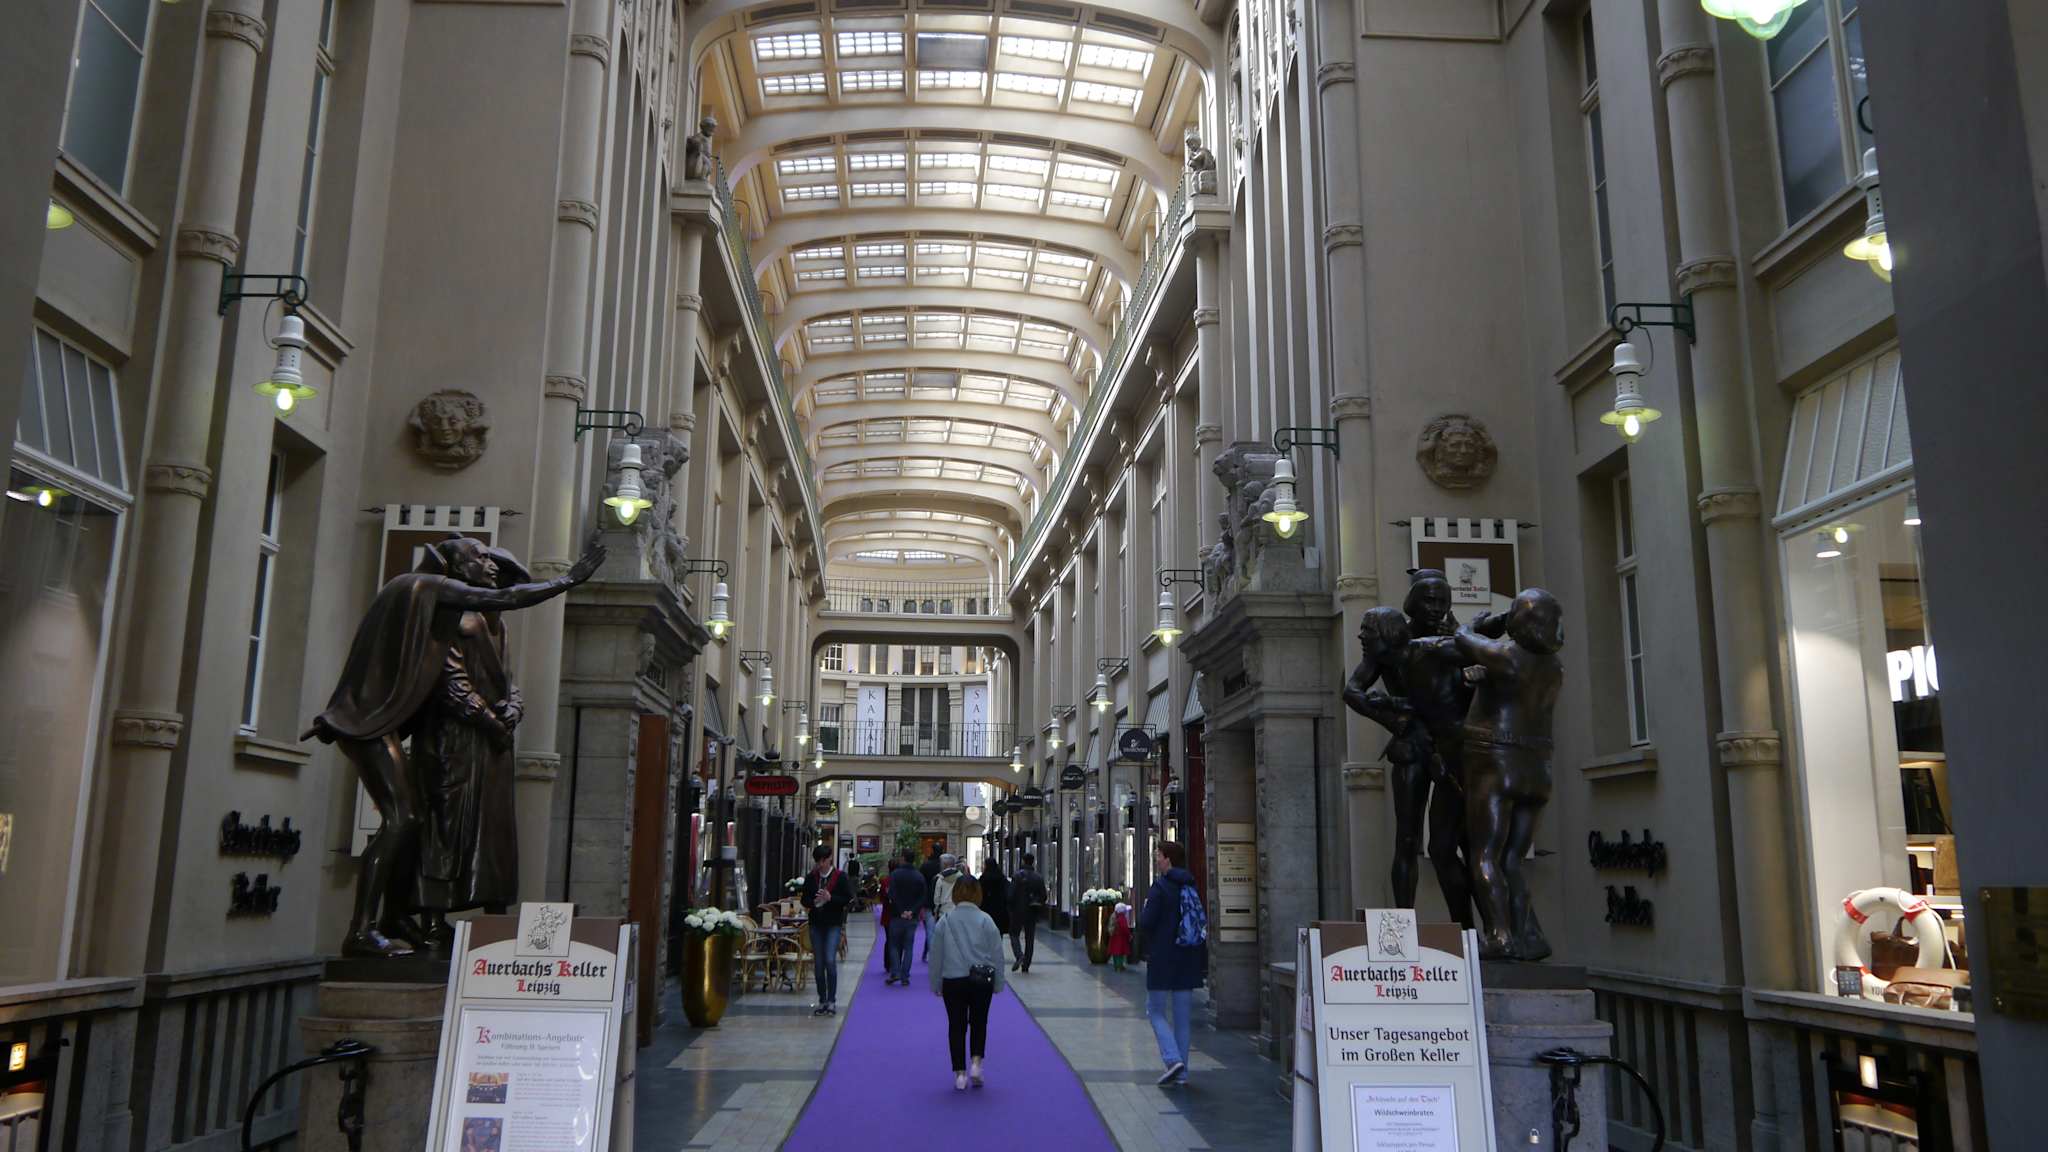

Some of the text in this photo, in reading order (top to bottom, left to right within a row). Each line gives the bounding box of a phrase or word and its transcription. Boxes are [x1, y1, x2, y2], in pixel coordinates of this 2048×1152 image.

[472, 958, 608, 979] Auerbachs Keller
[1330, 965, 1458, 984] Auerbachs Keller
[516, 978, 560, 995] Leipzig
[1375, 984, 1418, 1000] Leipzig
[1329, 1027, 1469, 1044] Unser Tagesangebot
[1341, 1047, 1460, 1062] im Großen Keller
